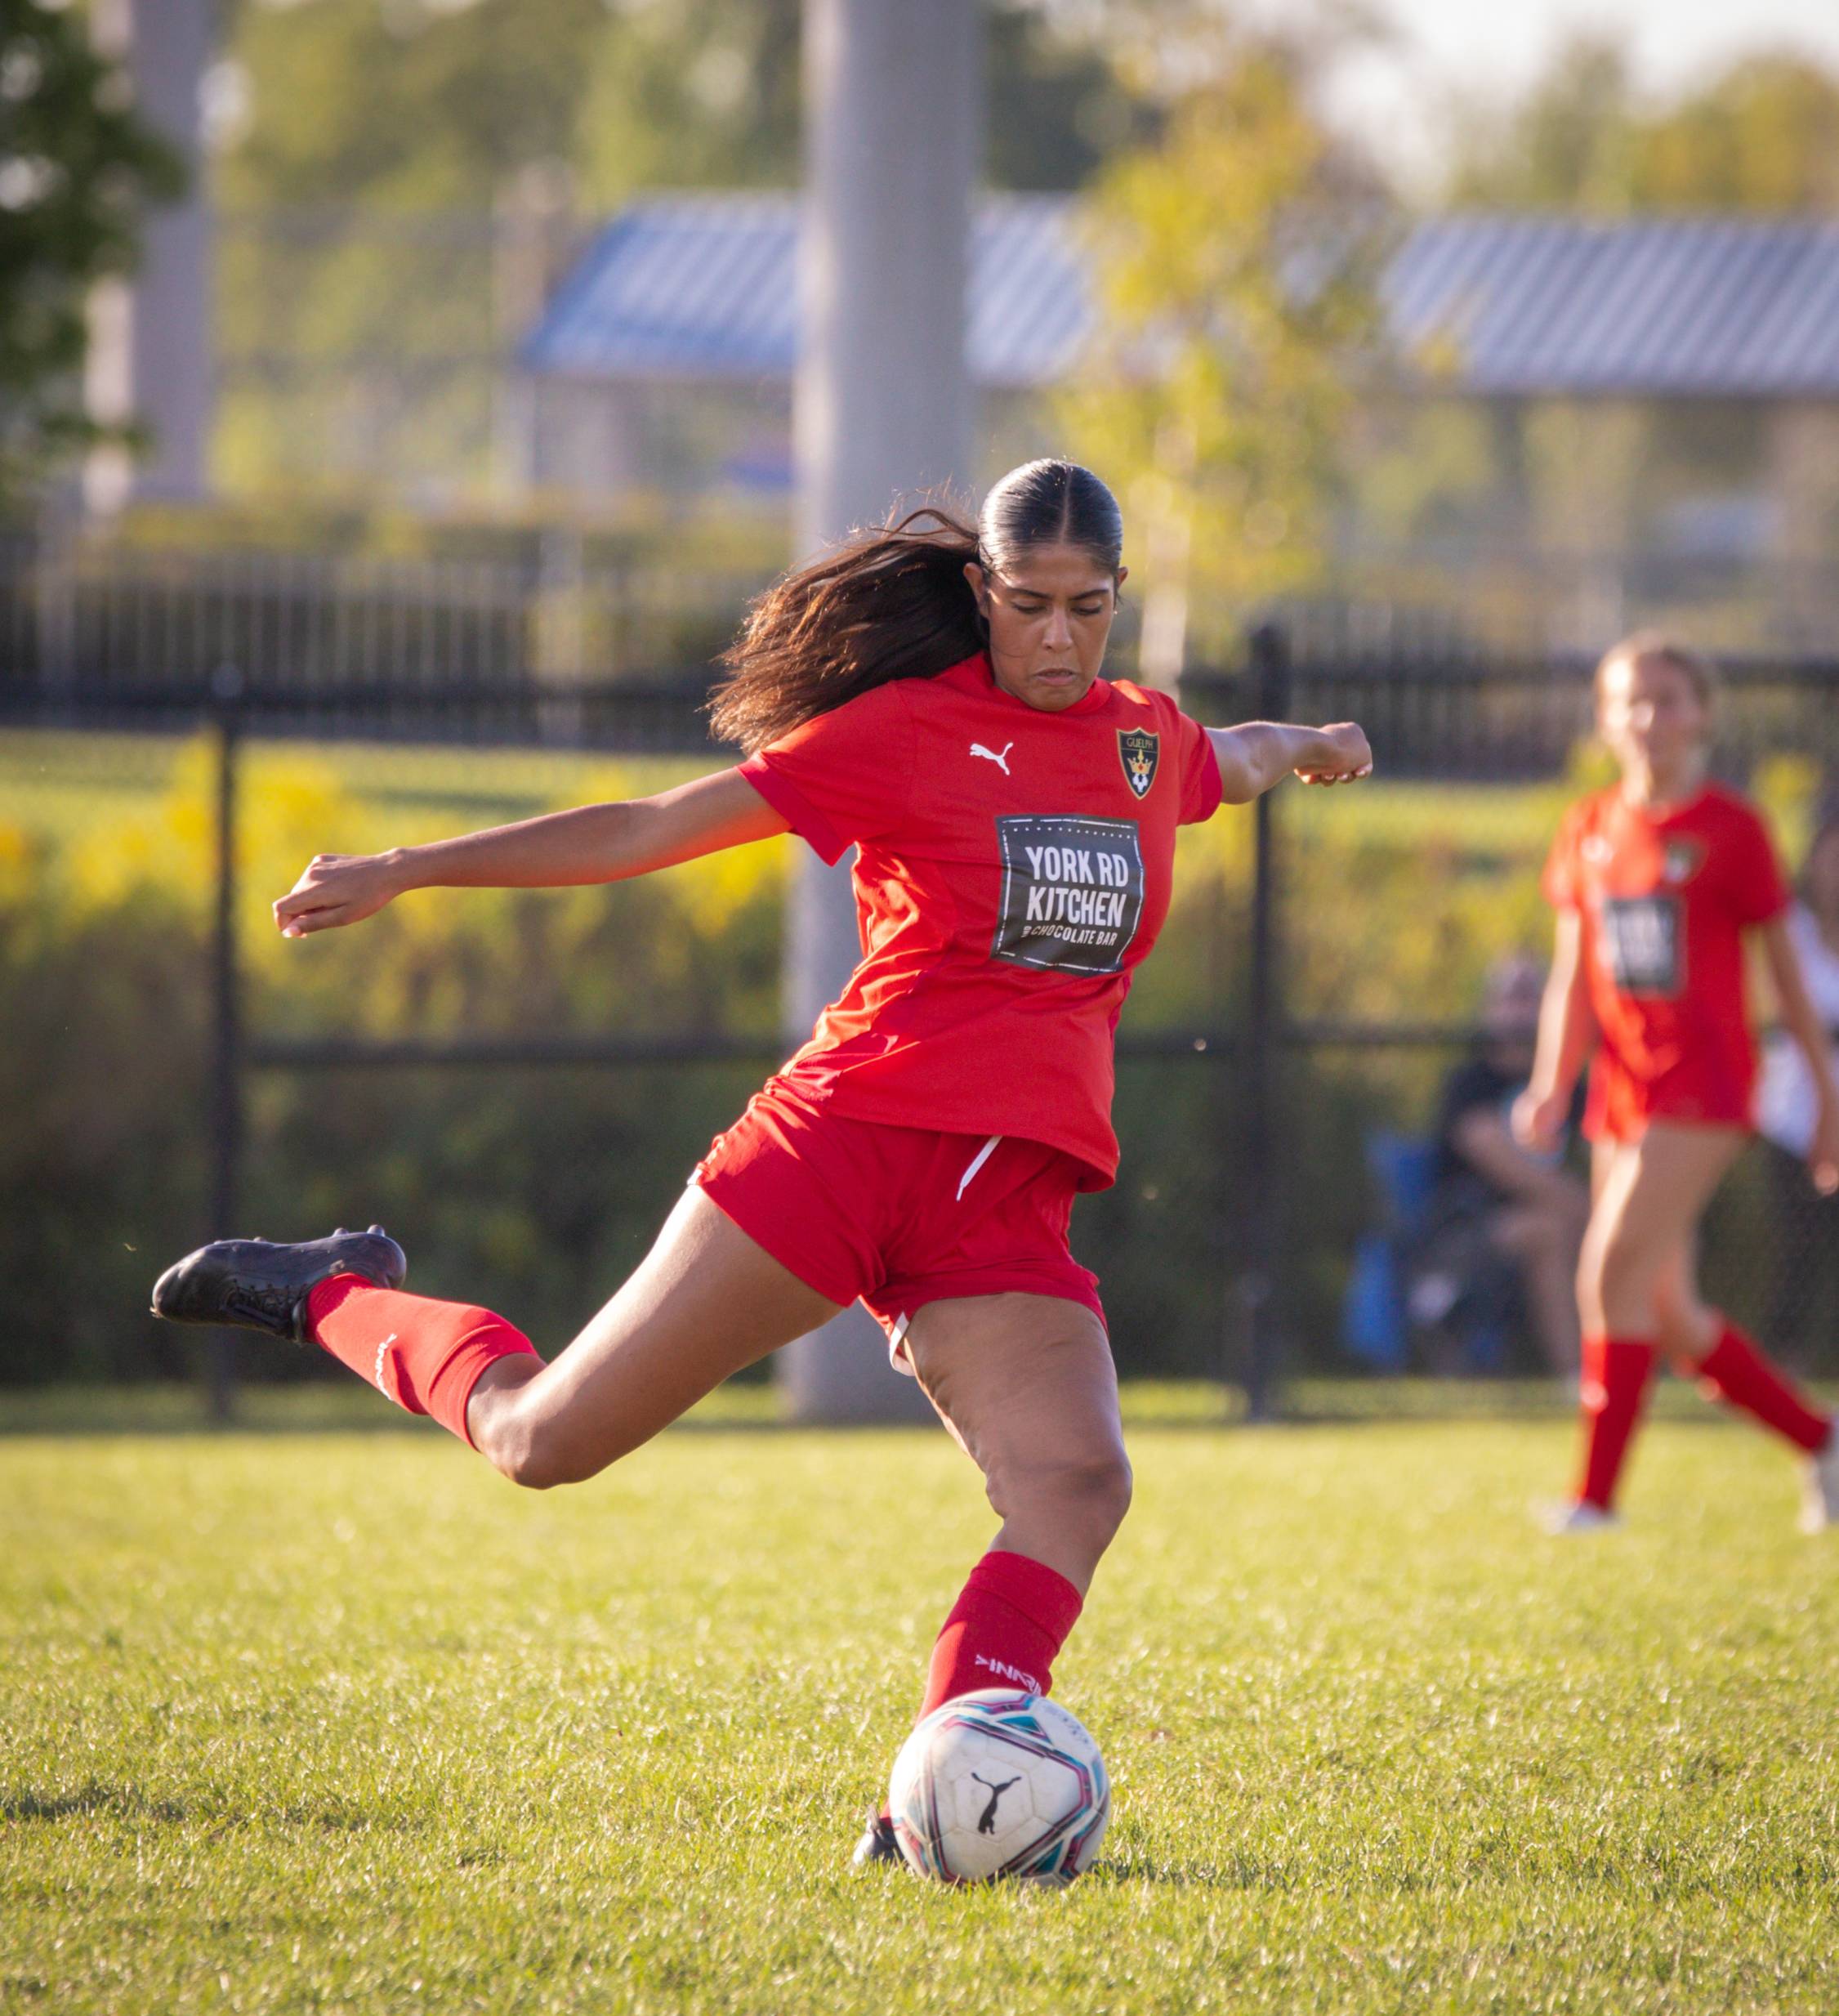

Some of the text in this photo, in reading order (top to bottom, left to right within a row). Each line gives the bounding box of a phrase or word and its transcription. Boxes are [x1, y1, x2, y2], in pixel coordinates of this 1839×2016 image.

[1024, 847, 1129, 887] YORK RD
[1026, 886, 1127, 928] KITCHEN
[1031, 925, 1118, 946] CHOCOLATE BAR
